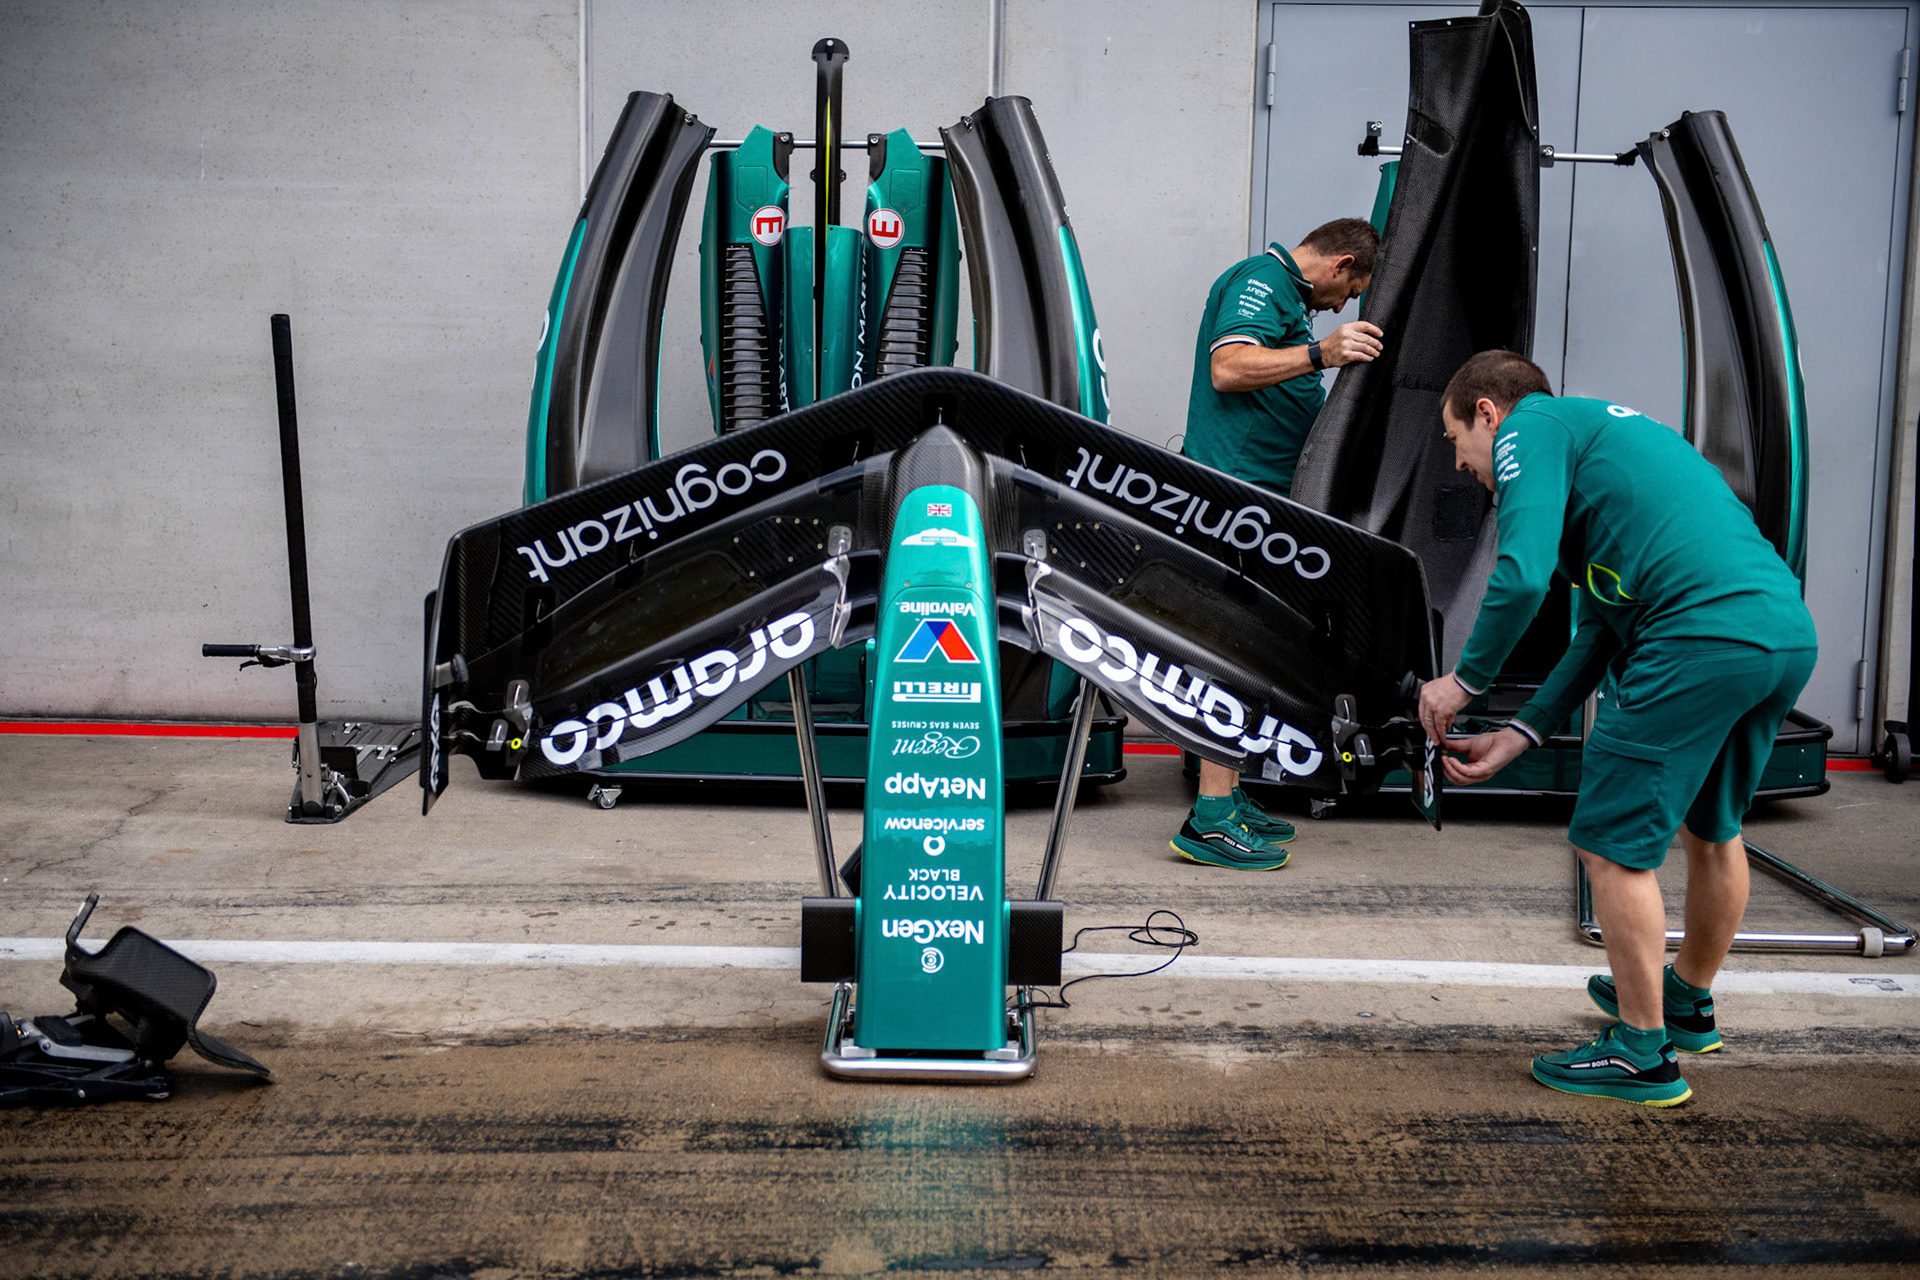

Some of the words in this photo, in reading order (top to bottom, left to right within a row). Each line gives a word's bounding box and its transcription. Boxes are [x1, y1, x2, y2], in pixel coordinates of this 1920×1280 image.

[756, 215, 783, 235] E
[872, 218, 899, 238] E
[516, 449, 787, 583] cognizant
[1066, 446, 1331, 579] cognizant
[900, 602, 977, 617] Valvoline
[540, 610, 816, 766] aramco
[892, 681, 982, 703] PIRELLI
[1058, 618, 1323, 776] aramco
[892, 720, 927, 729] CRUISES
[929, 721, 950, 730] SEAS
[953, 721, 980, 730] SEVEN
[892, 731, 981, 759] Regent
[884, 772, 986, 800] NetApp
[884, 817, 985, 835] servicenow
[908, 868, 961, 881] BLACK
[883, 884, 984, 901] VELOCITY
[882, 919, 984, 944] NexGen
[1590, 1059, 1609, 1068] BOSS
